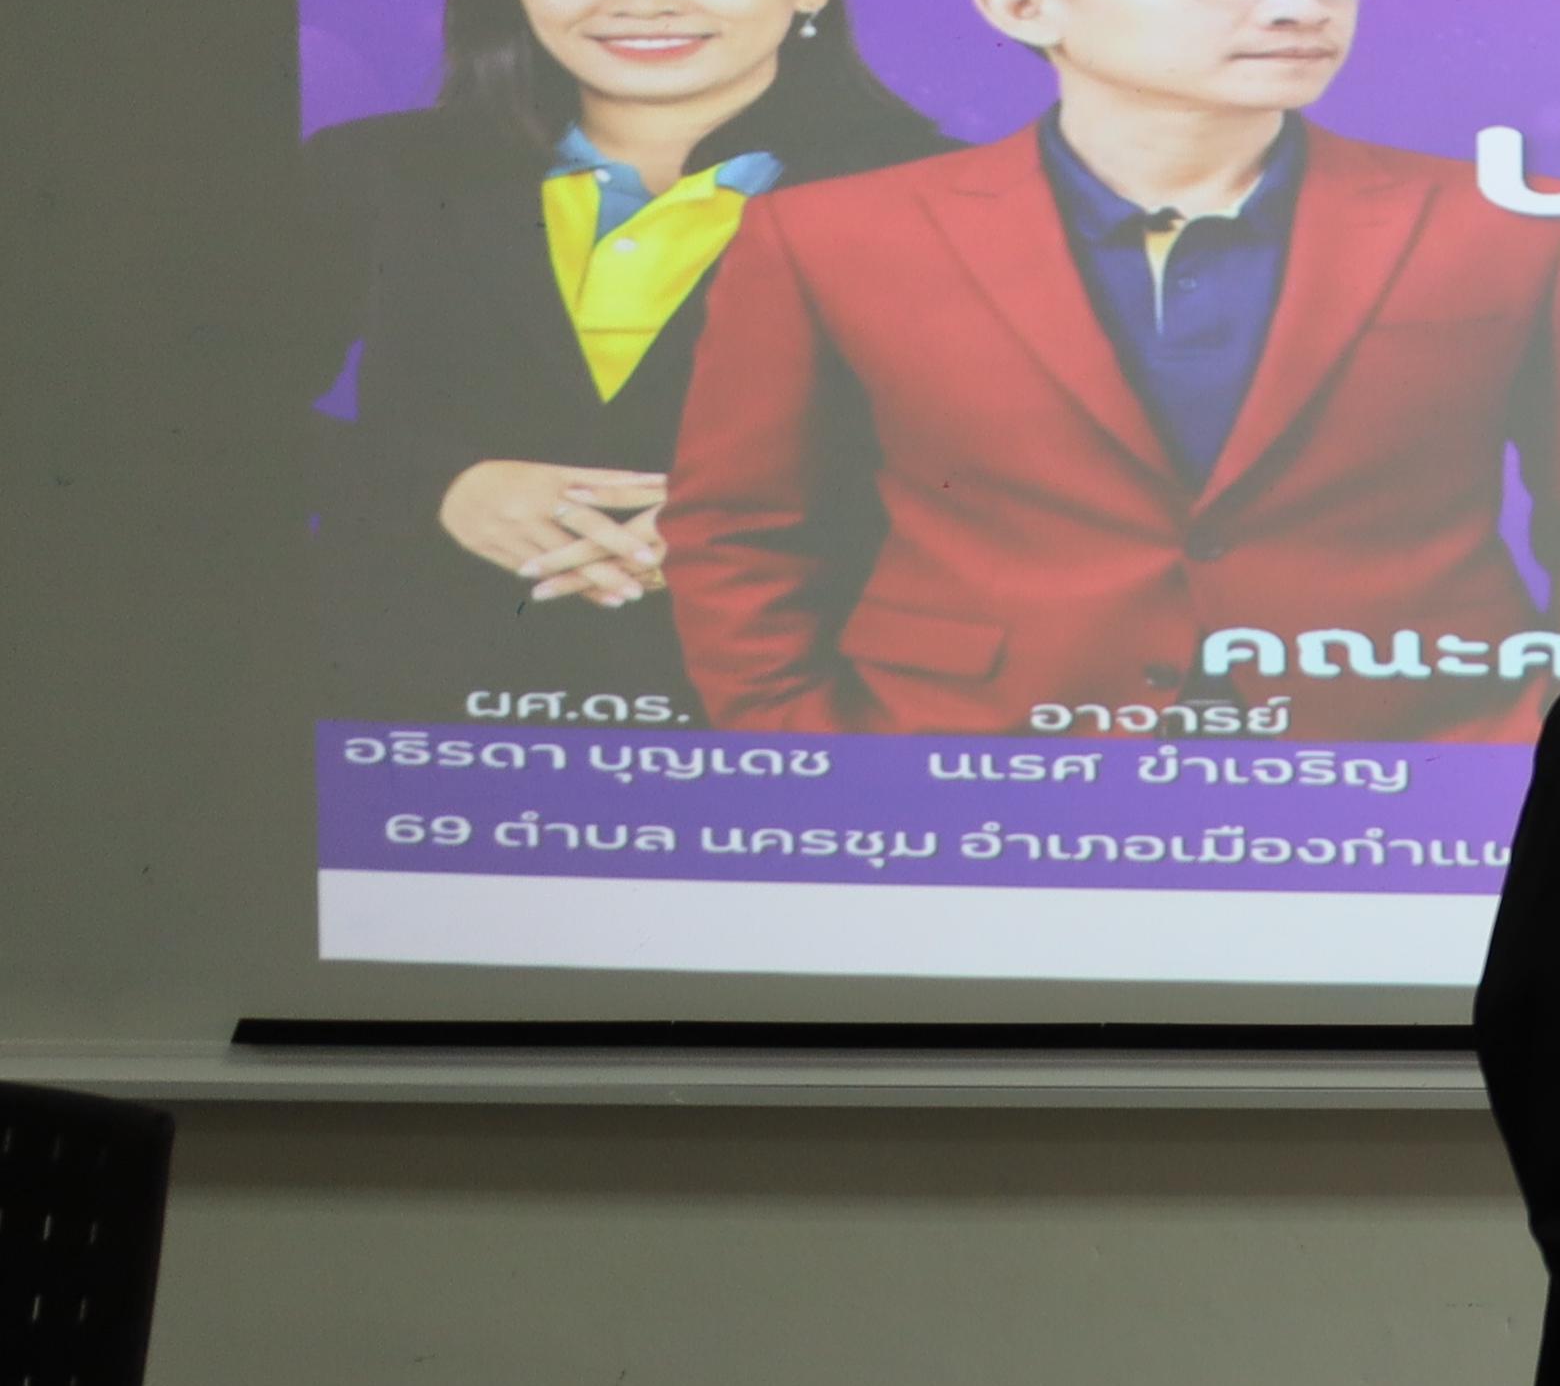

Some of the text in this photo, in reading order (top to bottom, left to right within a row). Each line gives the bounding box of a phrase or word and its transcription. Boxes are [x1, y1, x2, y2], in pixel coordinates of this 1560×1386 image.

[466, 690, 690, 722] ผศ.ดร.
[1030, 696, 1292, 734] อาจารย์
[588, 744, 832, 782] บุญเดช
[929, 746, 1410, 792] นเรศ ขำเจริญ
[385, 815, 471, 844] 69
[494, 811, 676, 851] ตำบล
